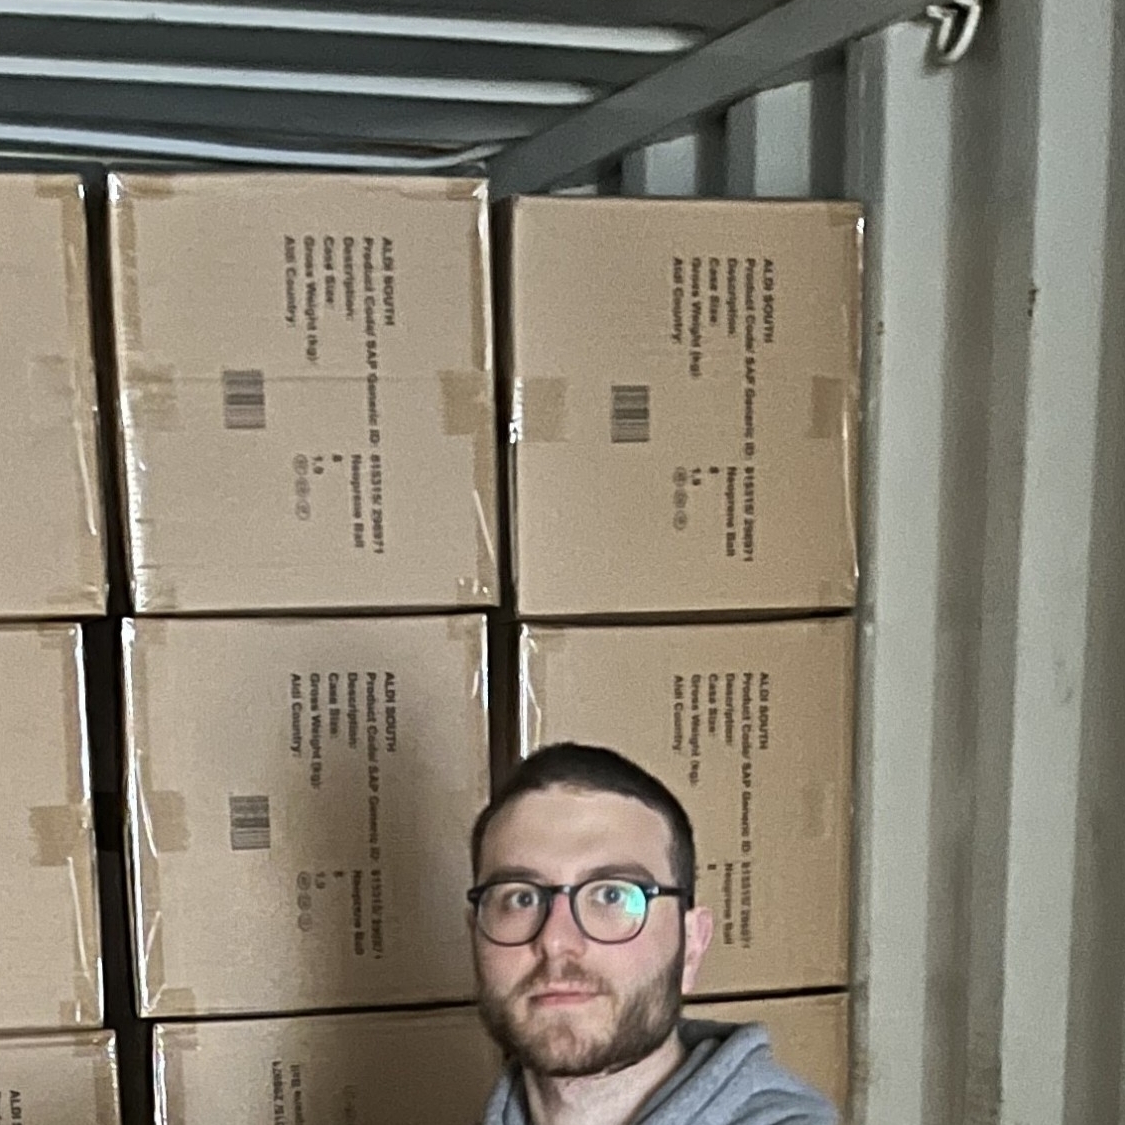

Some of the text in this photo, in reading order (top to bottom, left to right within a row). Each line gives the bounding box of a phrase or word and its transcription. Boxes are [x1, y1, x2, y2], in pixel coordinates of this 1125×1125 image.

[284, 235, 295, 263] Aldi
[303, 235, 314, 277] Gross
[323, 235, 334, 270] Case
[362, 236, 374, 291] Product
[673, 256, 683, 283] Aldi
[382, 237, 395, 325] ALDI SOUTH
[691, 257, 701, 297] Gross
[709, 257, 719, 290] Case
[745, 258, 755, 310] Product
[304, 282, 317, 330] Weight
[364, 296, 376, 336] Code/
[763, 258, 773, 342] ALDI SOUTH
[689, 301, 701, 347] Weight
[745, 314, 755, 352] Code/
[366, 340, 377, 369] SAP
[745, 356, 754, 384] SAP
[367, 373, 378, 425] Generic
[744, 388, 754, 438] Generic
[350, 454, 361, 518] Neoprene
[725, 466, 736, 528] Neoprene
[353, 522, 364, 548] Ball
[726, 532, 736, 556] Ball
[290, 673, 301, 698] Aldi
[309, 672, 320, 711] Gross
[328, 672, 339, 704] Case
[385, 672, 396, 752] ALDI SOUTH
[759, 671, 769, 748] ALDI SOUTH
[309, 714, 321, 758] Weight
[366, 672, 379, 843] Product Code/ SAP Generic
[9, 1090, 21, 1118] ALDI
